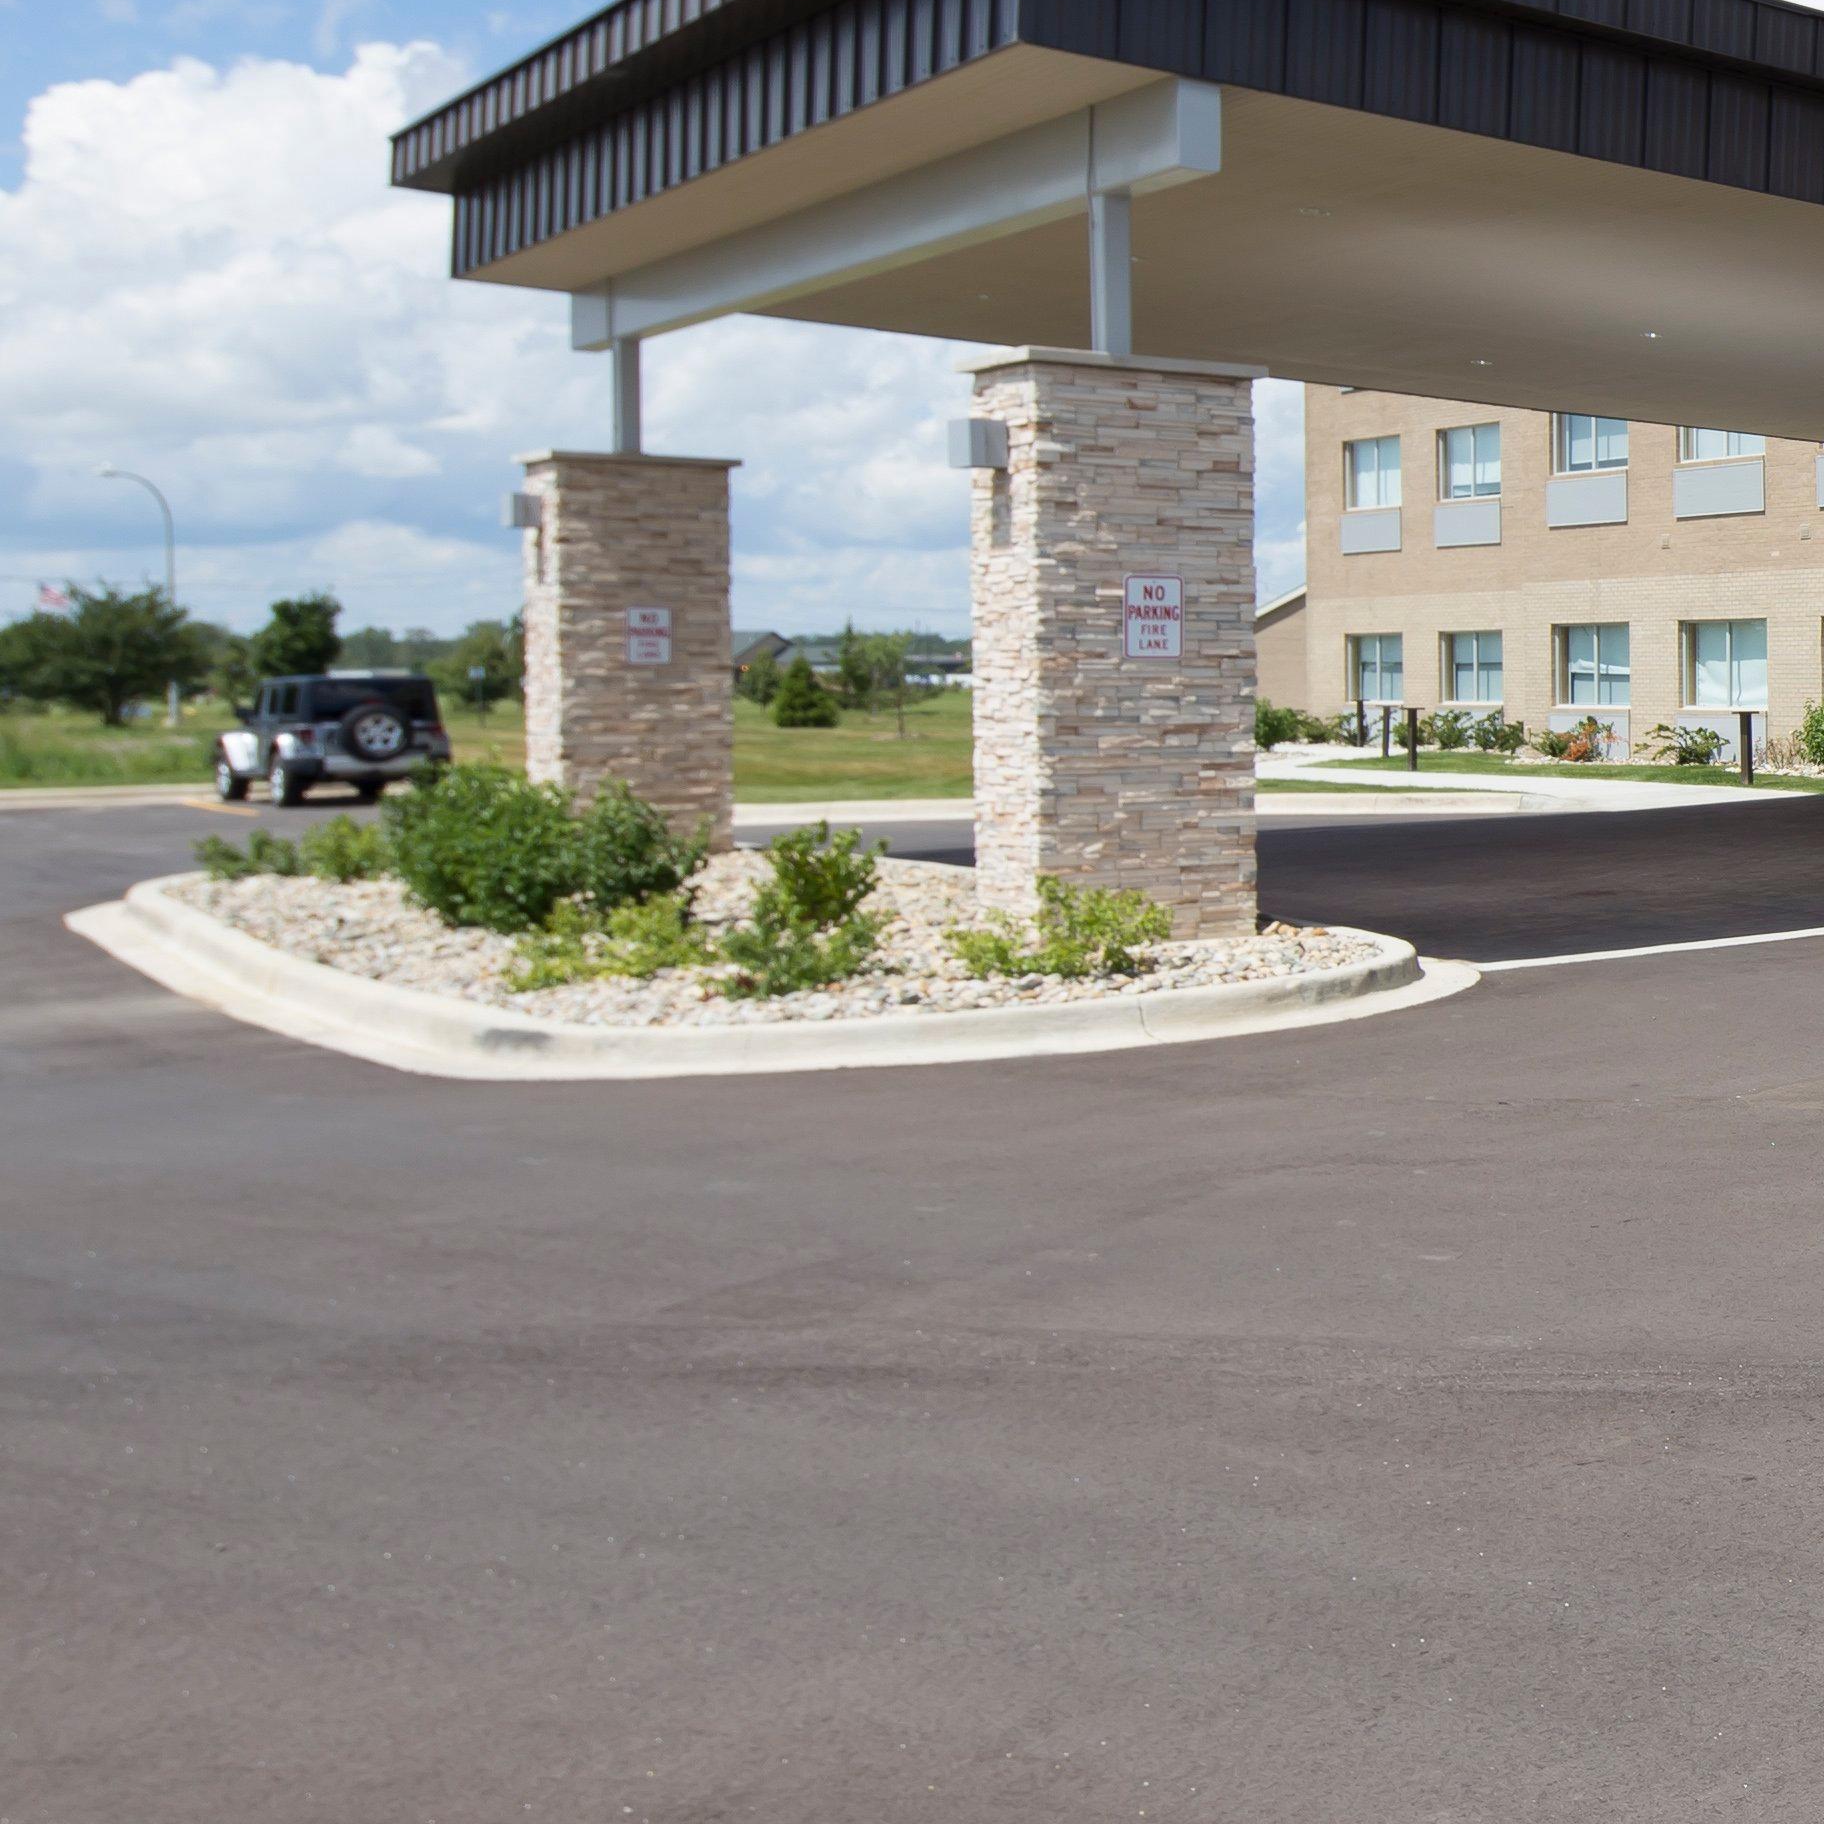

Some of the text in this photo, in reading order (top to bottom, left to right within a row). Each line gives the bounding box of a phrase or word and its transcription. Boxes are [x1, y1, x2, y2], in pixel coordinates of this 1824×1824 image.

[1143, 585, 1165, 601] NO
[1127, 605, 1180, 621] PARKING
[1141, 624, 1167, 636] FIRE
[1138, 638, 1169, 650] LANE
